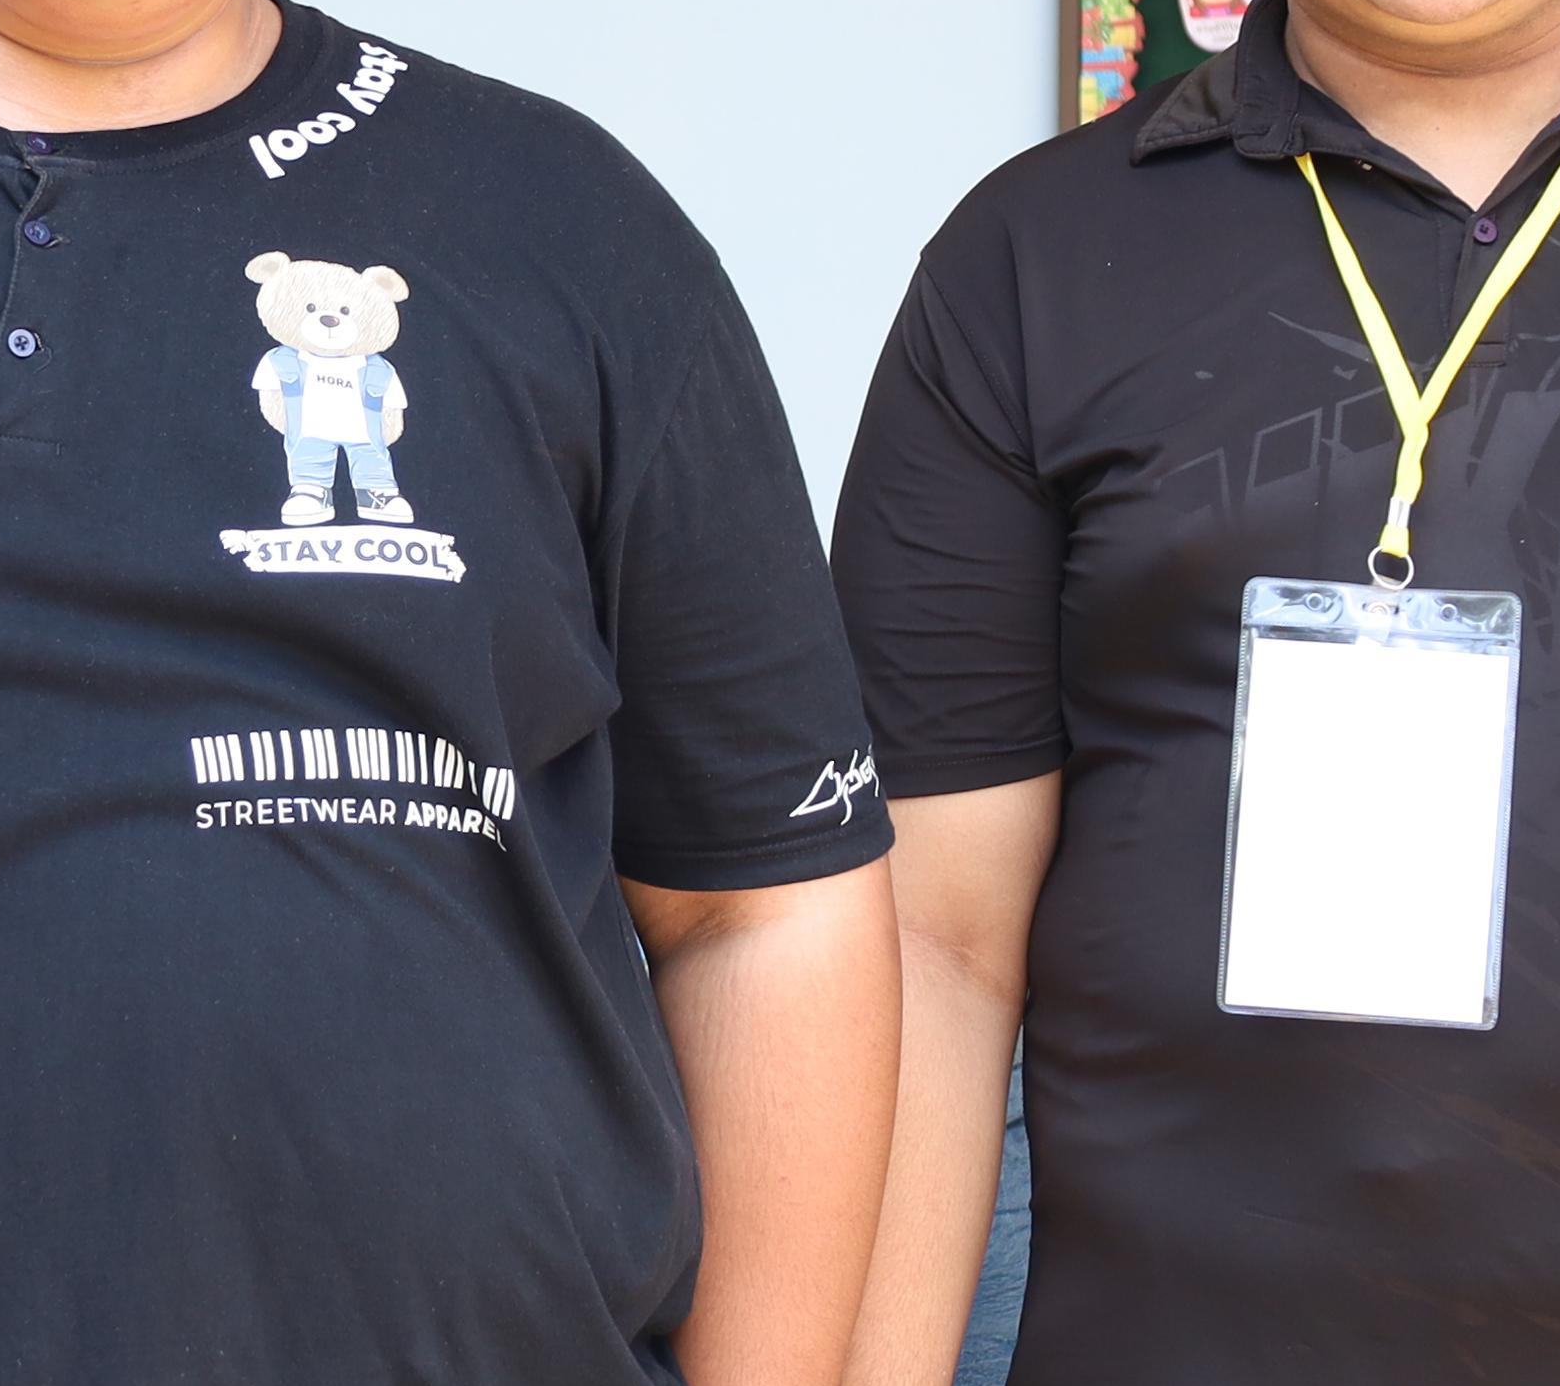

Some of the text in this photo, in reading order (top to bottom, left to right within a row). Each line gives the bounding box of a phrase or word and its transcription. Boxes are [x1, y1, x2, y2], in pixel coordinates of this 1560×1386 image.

[249, 41, 409, 179] stay cool
[316, 374, 354, 389] HORA
[257, 538, 450, 571] STAY COOL
[195, 798, 397, 830] STREETWEAR
